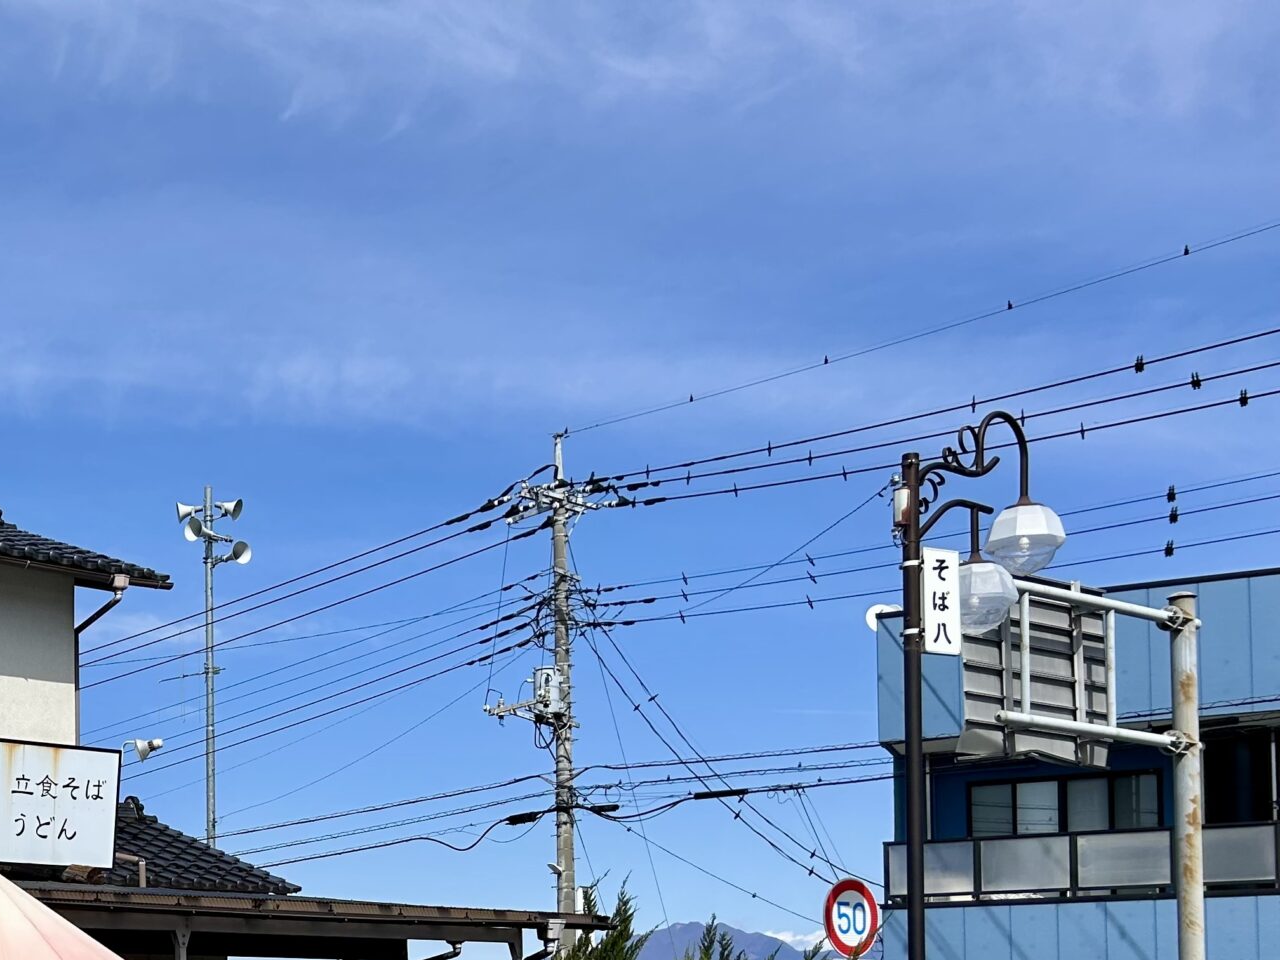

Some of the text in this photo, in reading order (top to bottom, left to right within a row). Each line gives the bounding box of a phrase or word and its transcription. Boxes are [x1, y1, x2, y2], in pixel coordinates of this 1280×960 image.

[932, 558, 952, 645] そば八
[10, 773, 108, 801] 立食そば
[13, 812, 78, 841] うどん
[836, 901, 867, 935] 50
